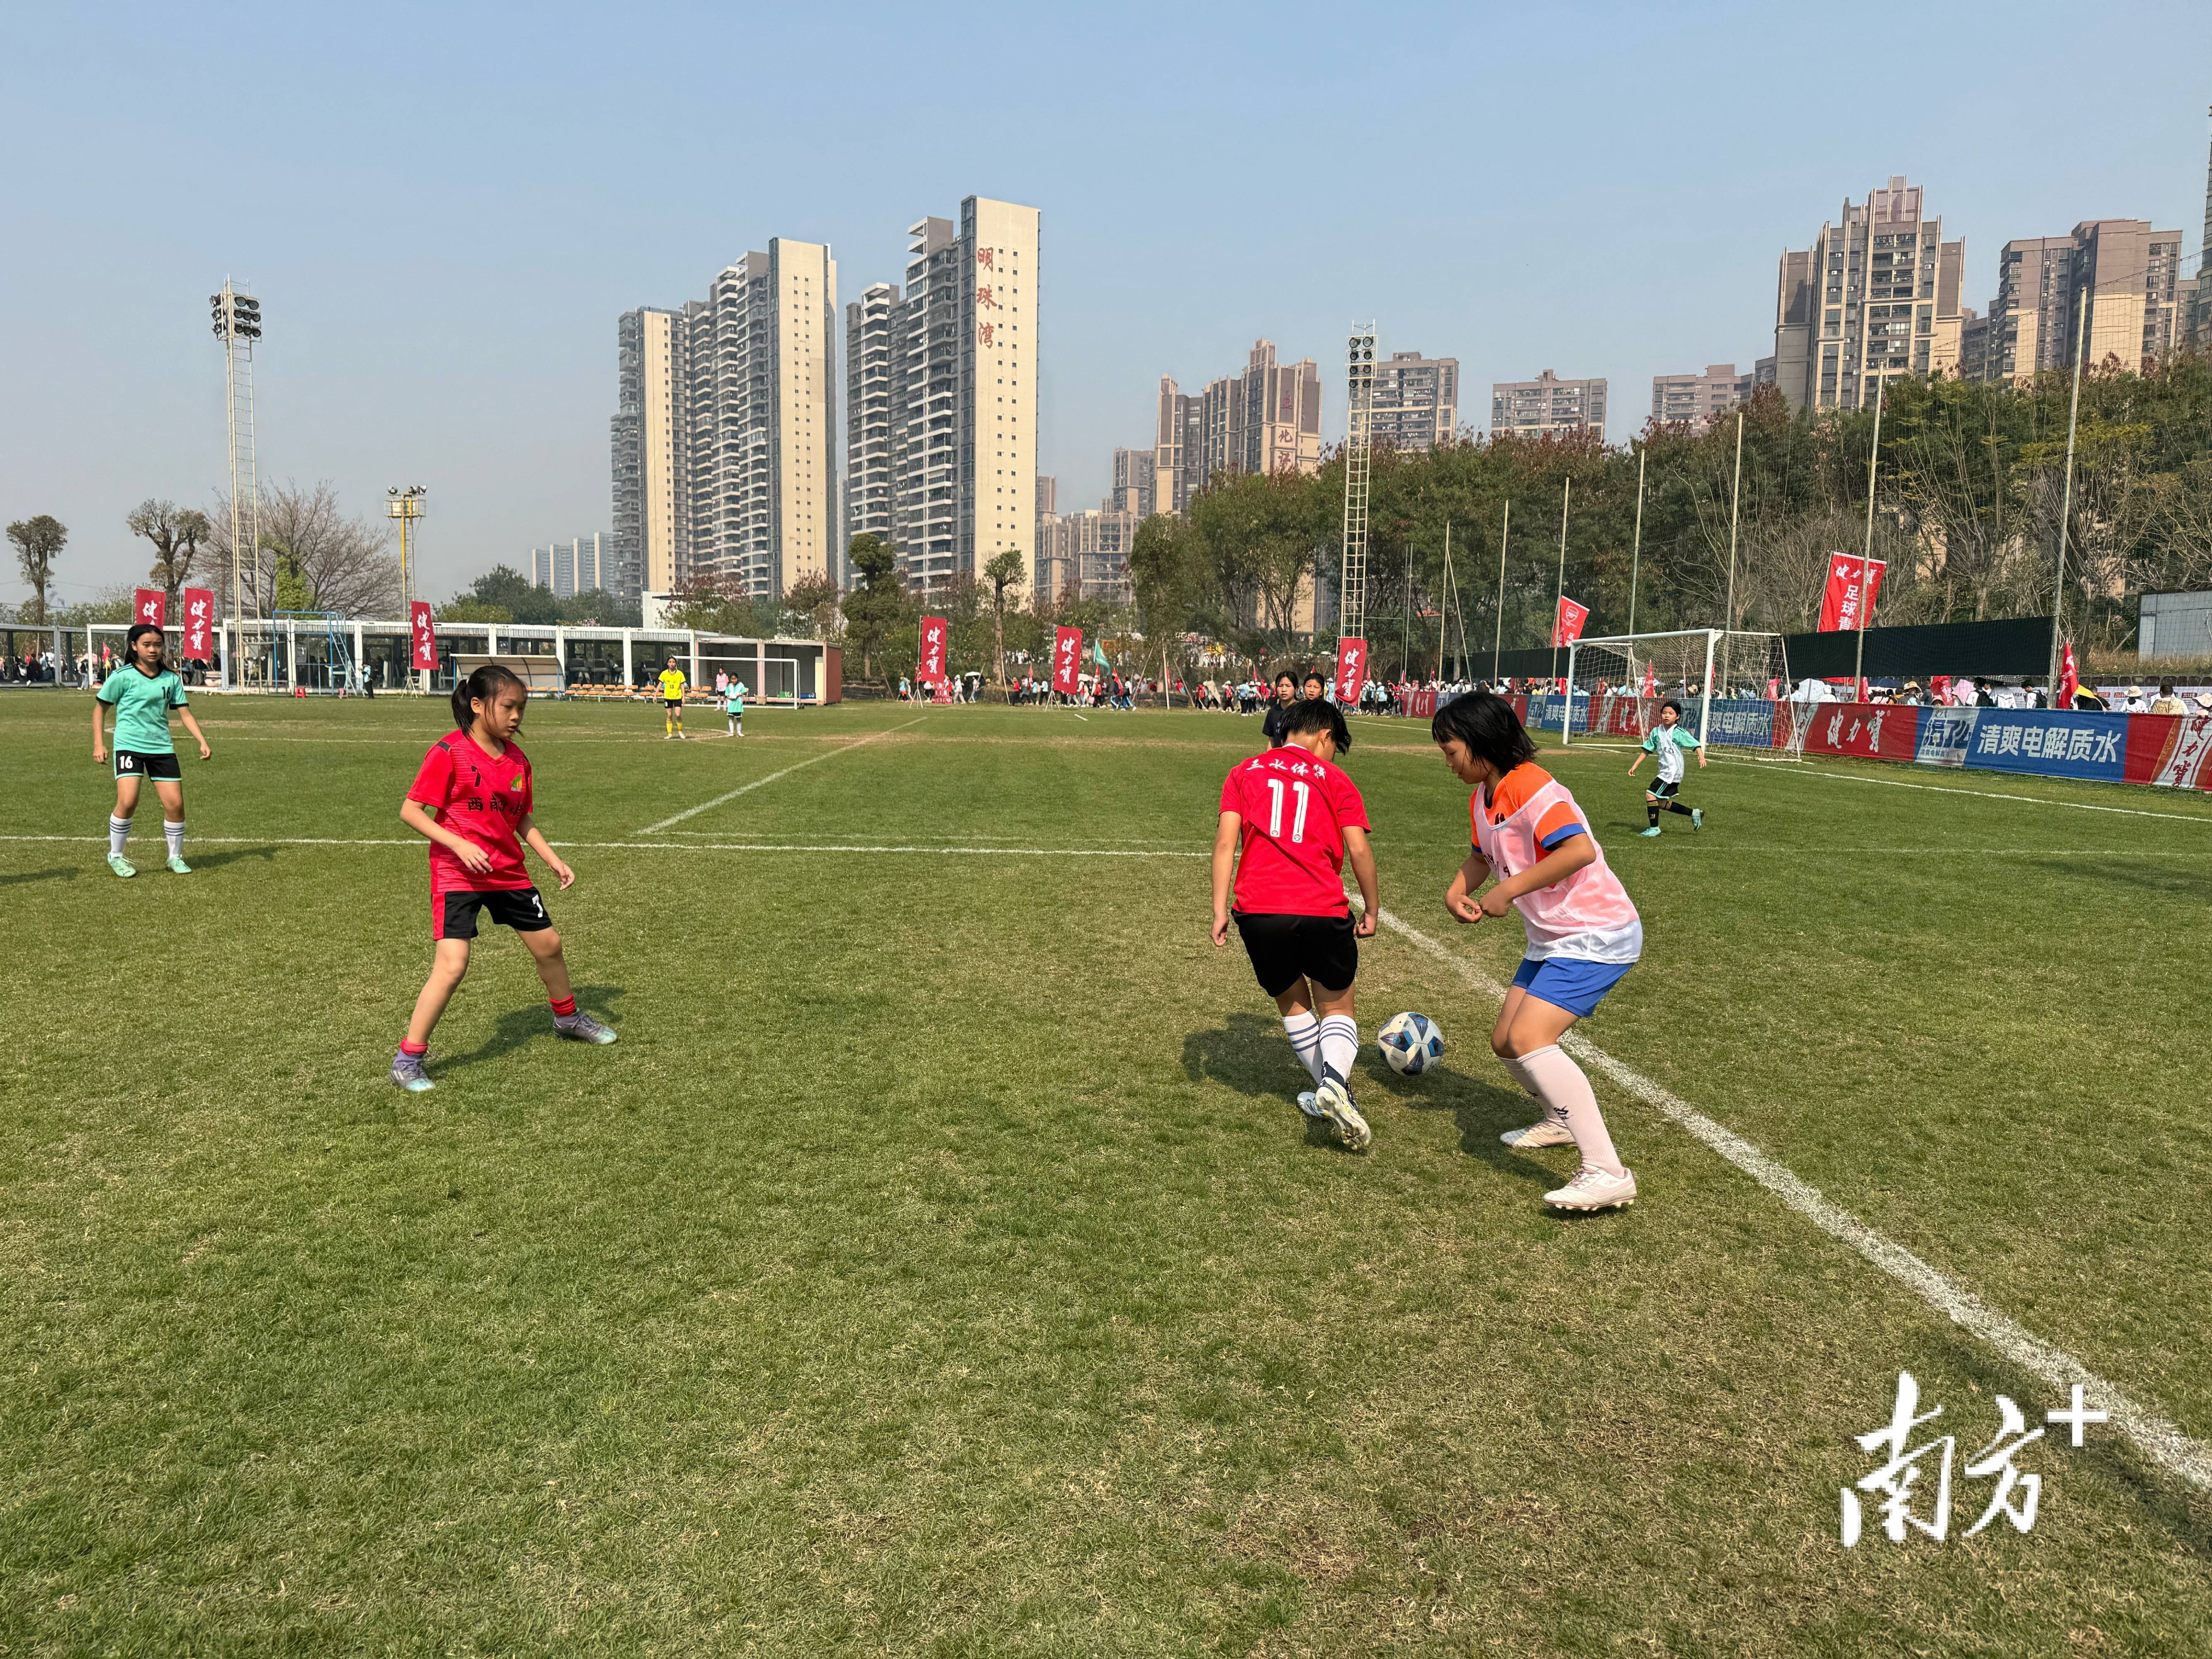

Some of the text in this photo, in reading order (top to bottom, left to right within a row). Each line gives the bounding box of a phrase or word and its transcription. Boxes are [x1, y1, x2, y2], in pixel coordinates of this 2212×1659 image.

[977, 247, 997, 349] 明珠湾
[142, 600, 158, 625] 健
[162, 687, 170, 699] 16
[1545, 704, 1588, 723] 清爽电质水
[1977, 725, 2122, 763] 清爽电解质水
[120, 756, 133, 769] 16
[1268, 778, 1309, 843] 11
[532, 894, 543, 918] 7
